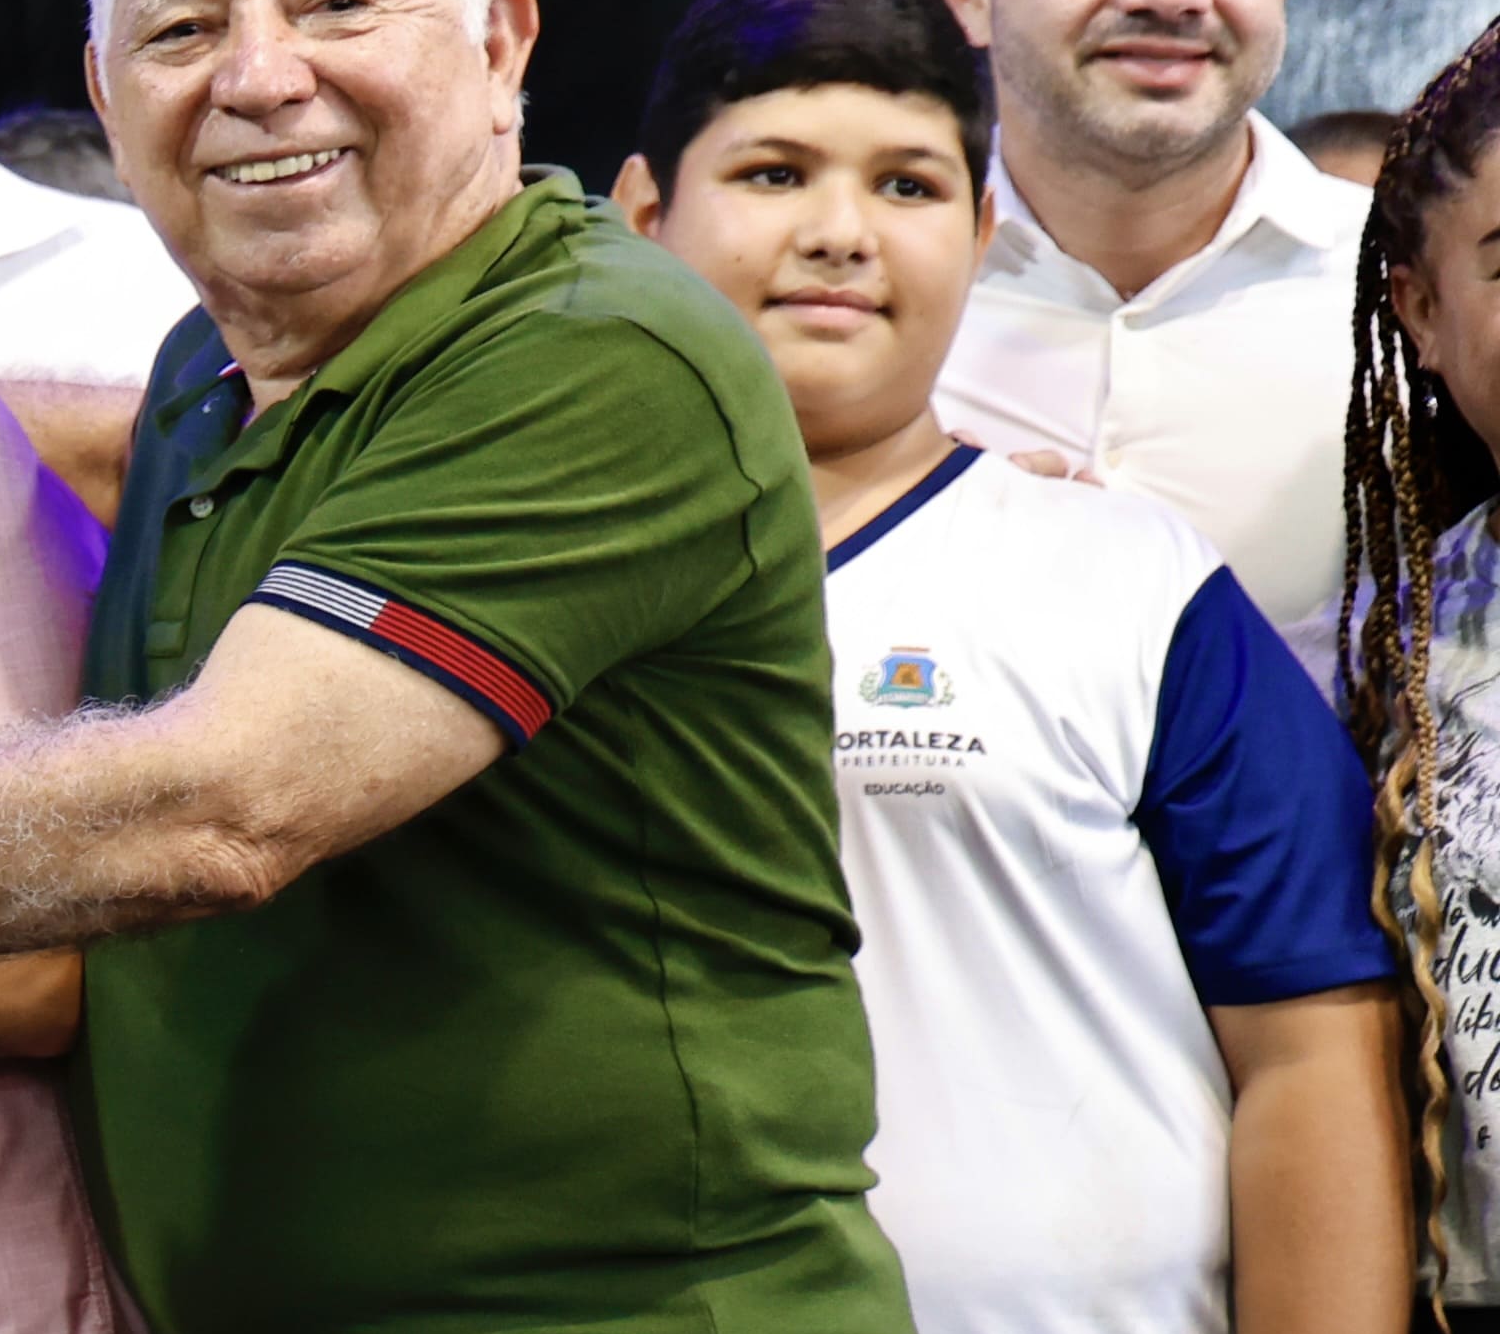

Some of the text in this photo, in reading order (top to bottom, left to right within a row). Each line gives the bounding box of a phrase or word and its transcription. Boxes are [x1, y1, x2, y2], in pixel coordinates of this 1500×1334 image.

[836, 730, 987, 755] ORTALEZA
[841, 755, 965, 767] PREFEITURA
[863, 780, 946, 797] EDUCAÇÃO
